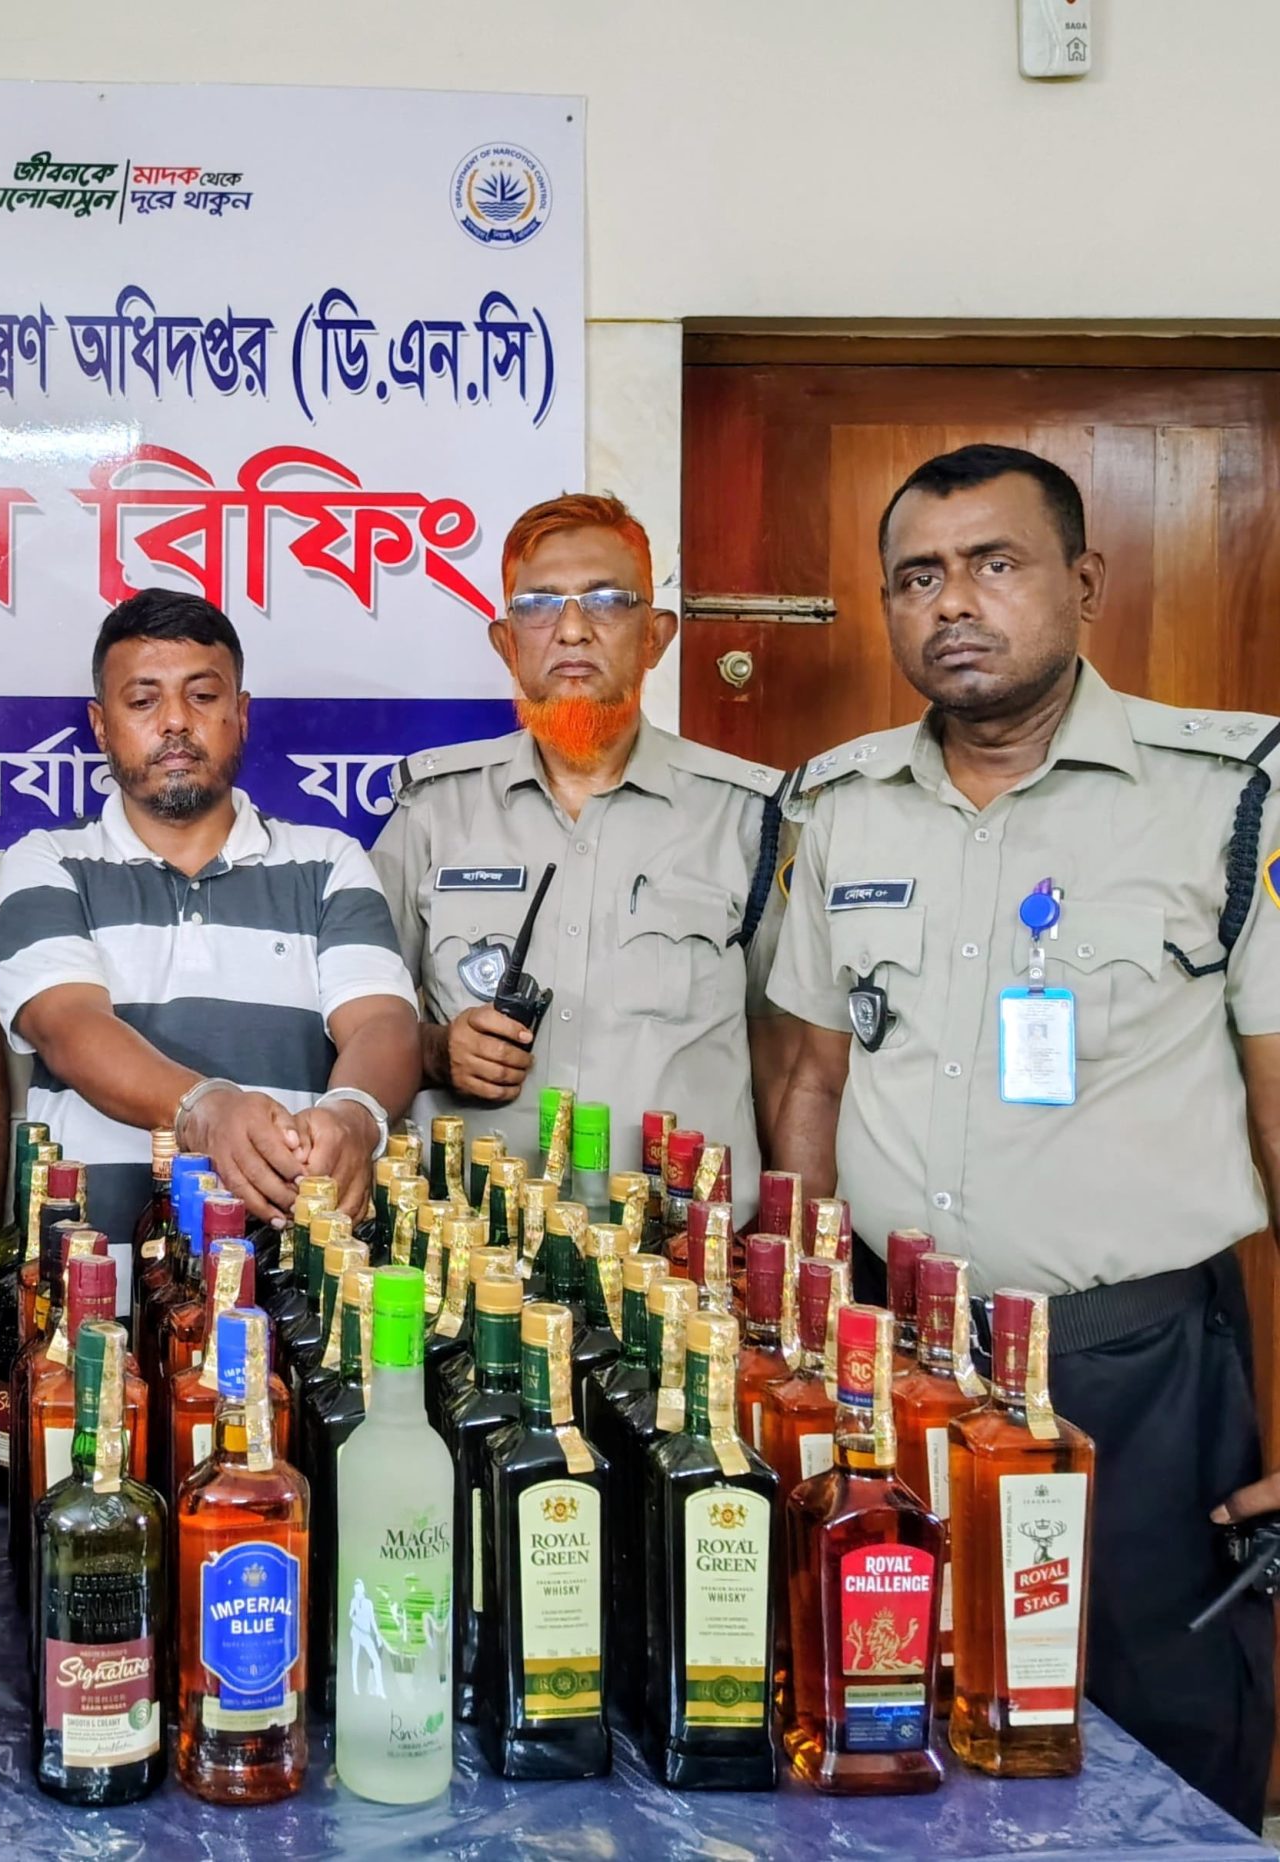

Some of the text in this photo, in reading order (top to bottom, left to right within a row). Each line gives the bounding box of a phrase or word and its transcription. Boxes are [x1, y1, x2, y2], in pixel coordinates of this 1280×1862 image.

[13, 151, 119, 187] জীবনকে
[132, 166, 244, 188] মাদক থেকে
[455, 147, 548, 211] DEPARTMENT OF NARCOTICS CONTROL
[130, 190, 254, 217] দূরে থাকুন
[64, 284, 275, 397] অধিদপ্তর
[385, 1522, 448, 1547] MAGIC
[531, 1532, 591, 1551] ROYAL
[696, 1538, 759, 1556] ROYAL
[530, 1549, 590, 1567] GREEN
[696, 1555, 758, 1573] GREEN
[865, 1555, 914, 1576] ROYAL
[845, 1575, 931, 1593] CHALLENGE
[1019, 1563, 1065, 1588] ROYAL
[543, 1585, 581, 1597] WHISKY
[708, 1592, 747, 1603] WHISKY
[210, 1596, 293, 1621] IMPERIAL
[1023, 1591, 1060, 1613] STAG
[231, 1617, 276, 1635] BLUE
[56, 1656, 151, 1690] Signature
[97, 1718, 122, 1727] CREAMY
